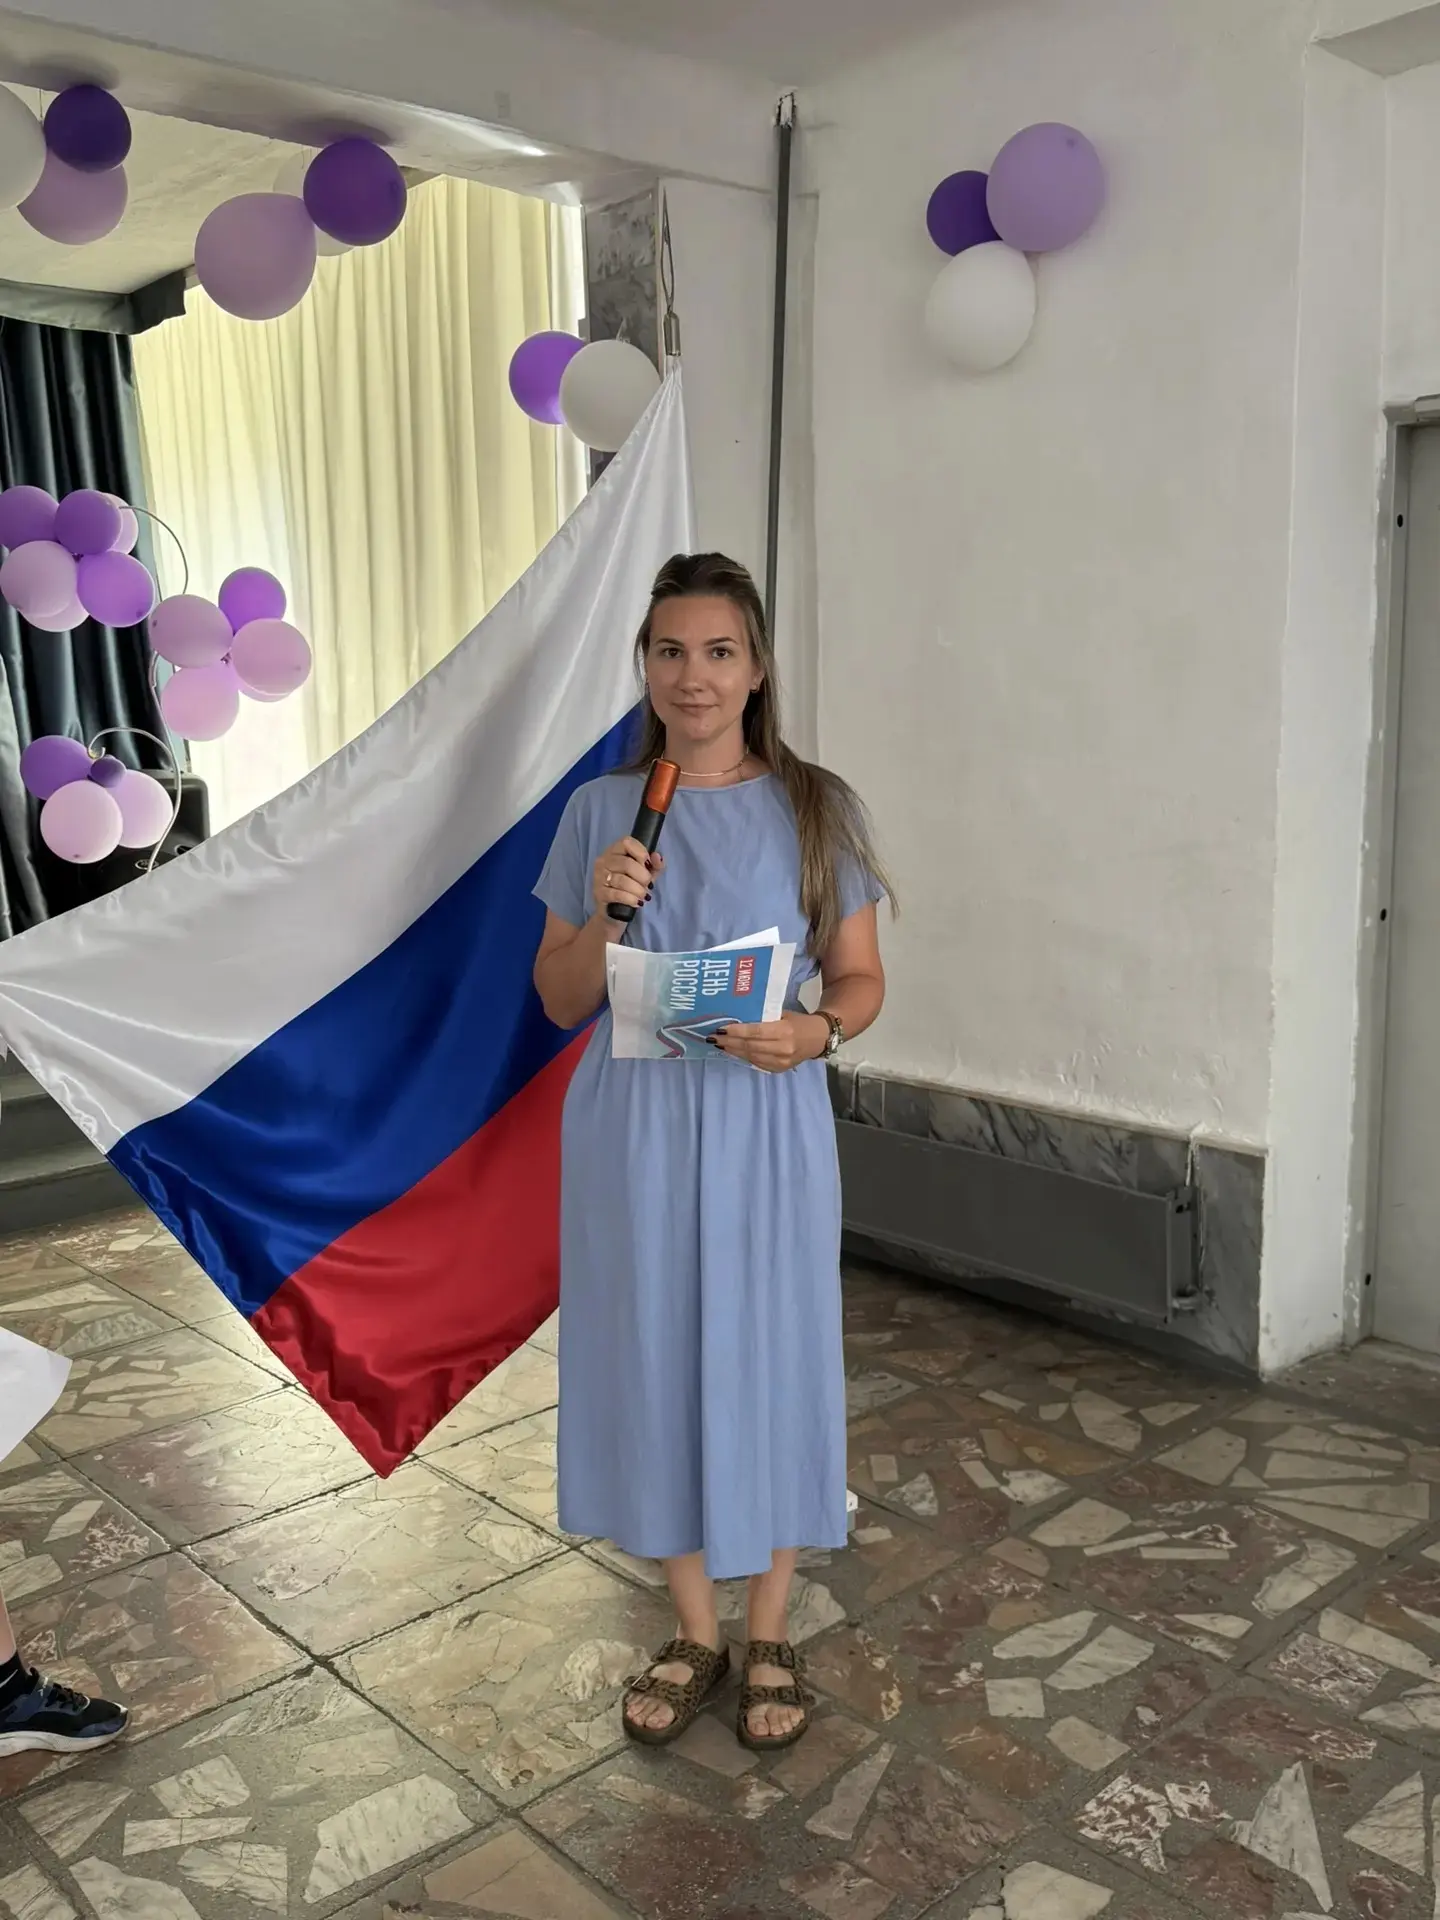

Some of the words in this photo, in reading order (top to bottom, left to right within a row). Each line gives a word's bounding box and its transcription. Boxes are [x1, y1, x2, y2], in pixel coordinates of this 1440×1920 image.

[701, 959, 731, 996] ДЕНЬ
[739, 959, 754, 969] 12
[669, 959, 700, 1010] РОССИИ
[735, 969, 752, 992] ИЮНЯ
